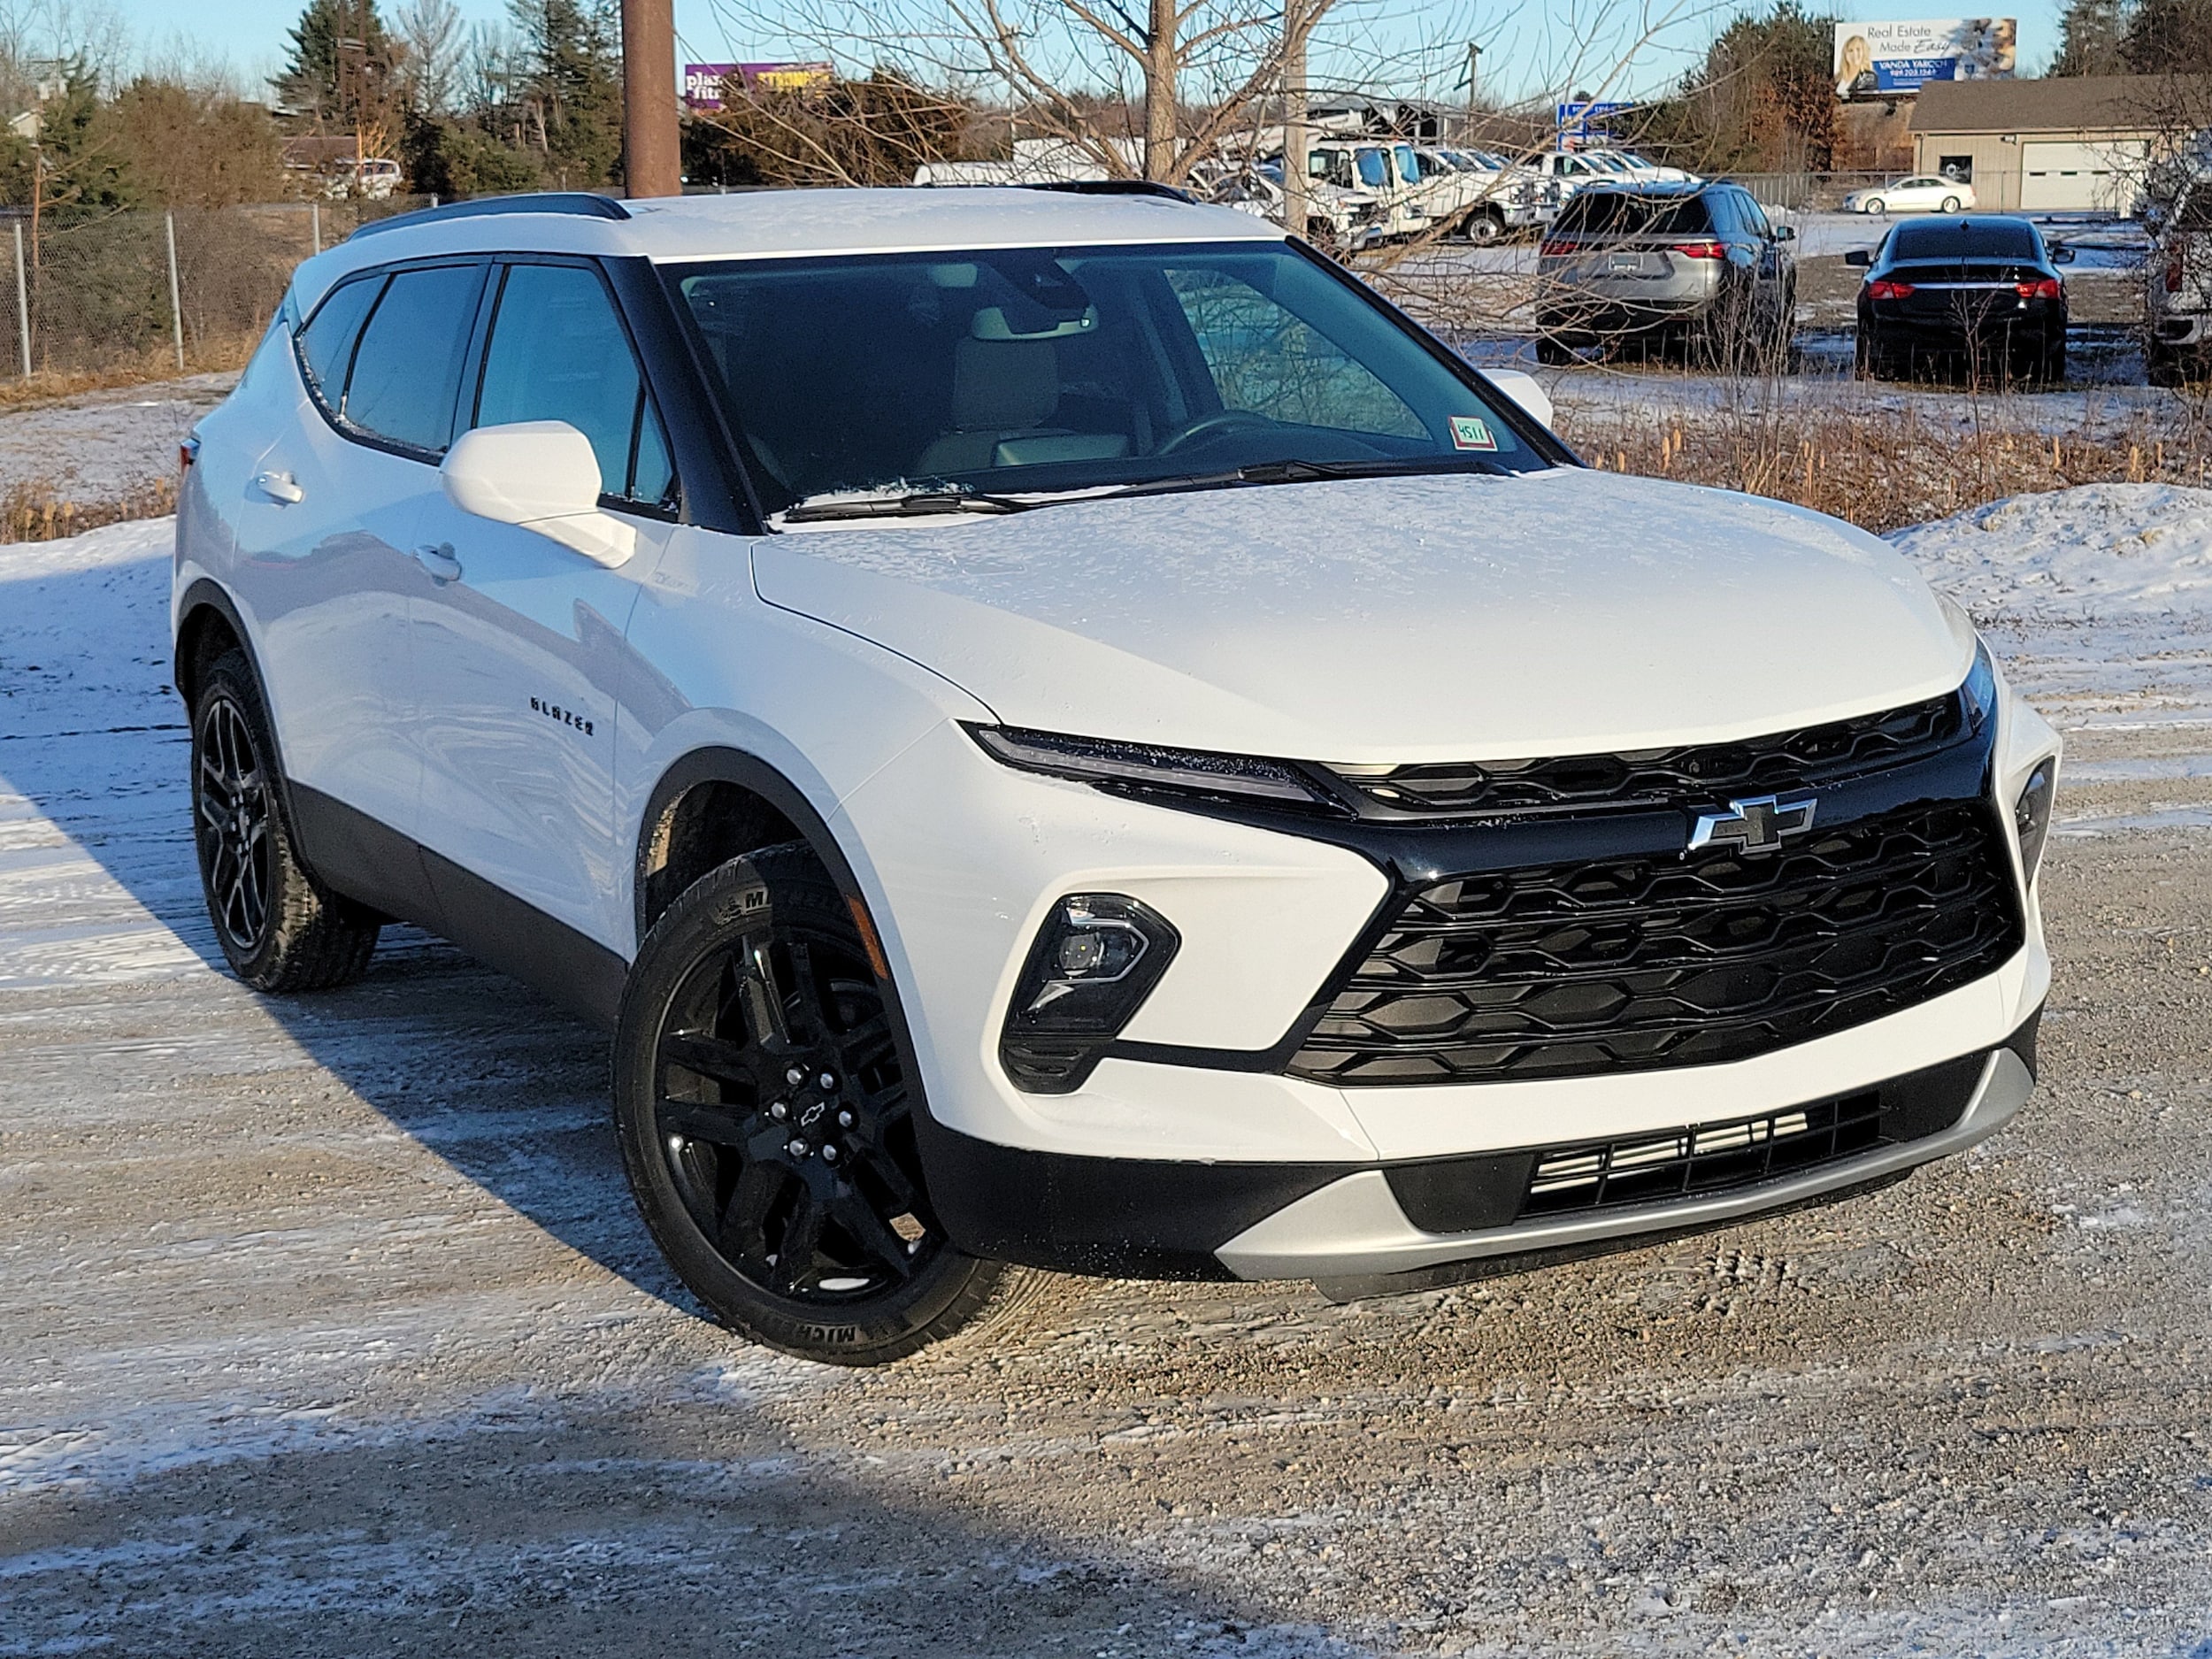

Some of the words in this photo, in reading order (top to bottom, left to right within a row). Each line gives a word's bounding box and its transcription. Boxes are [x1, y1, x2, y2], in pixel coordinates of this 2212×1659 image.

[1868, 24, 1893, 38] Real
[1897, 26, 1931, 36] Estate
[1879, 40, 1911, 52] Made
[1914, 38, 1950, 57] Easy
[531, 696, 593, 736] BLAZER
